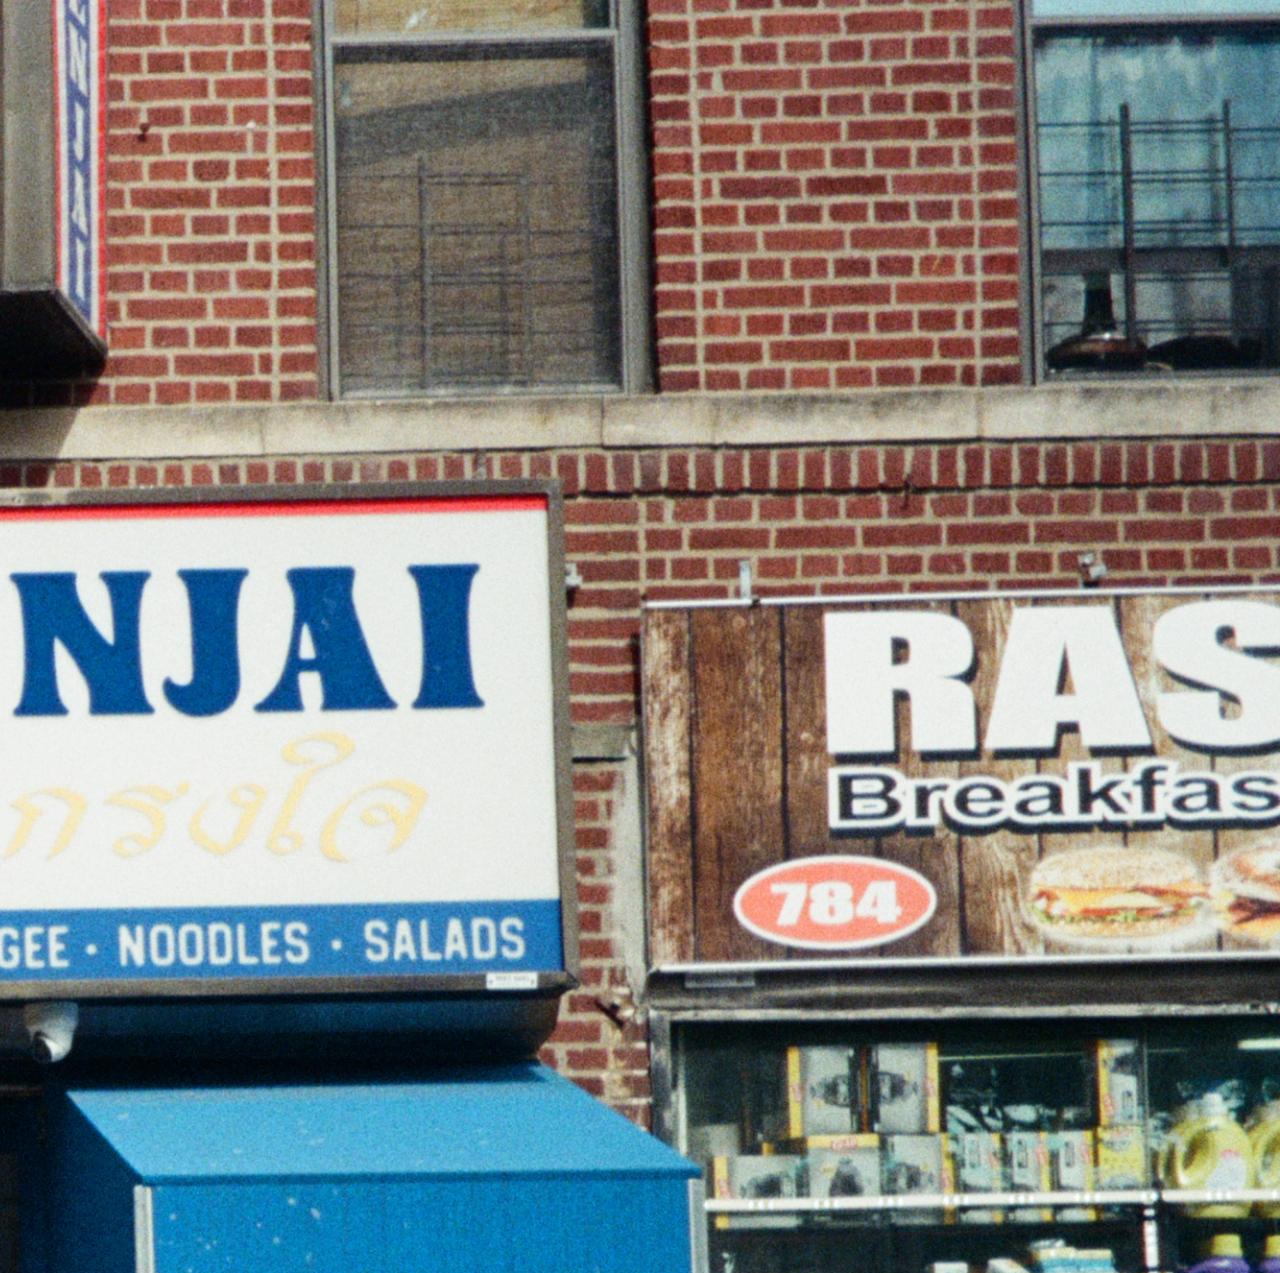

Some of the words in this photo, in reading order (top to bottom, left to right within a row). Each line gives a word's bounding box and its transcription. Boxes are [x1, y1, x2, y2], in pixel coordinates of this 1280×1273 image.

[770, 879, 902, 927] 784
[117, 921, 310, 967] NOODLES
[363, 916, 526, 963] SALADS
